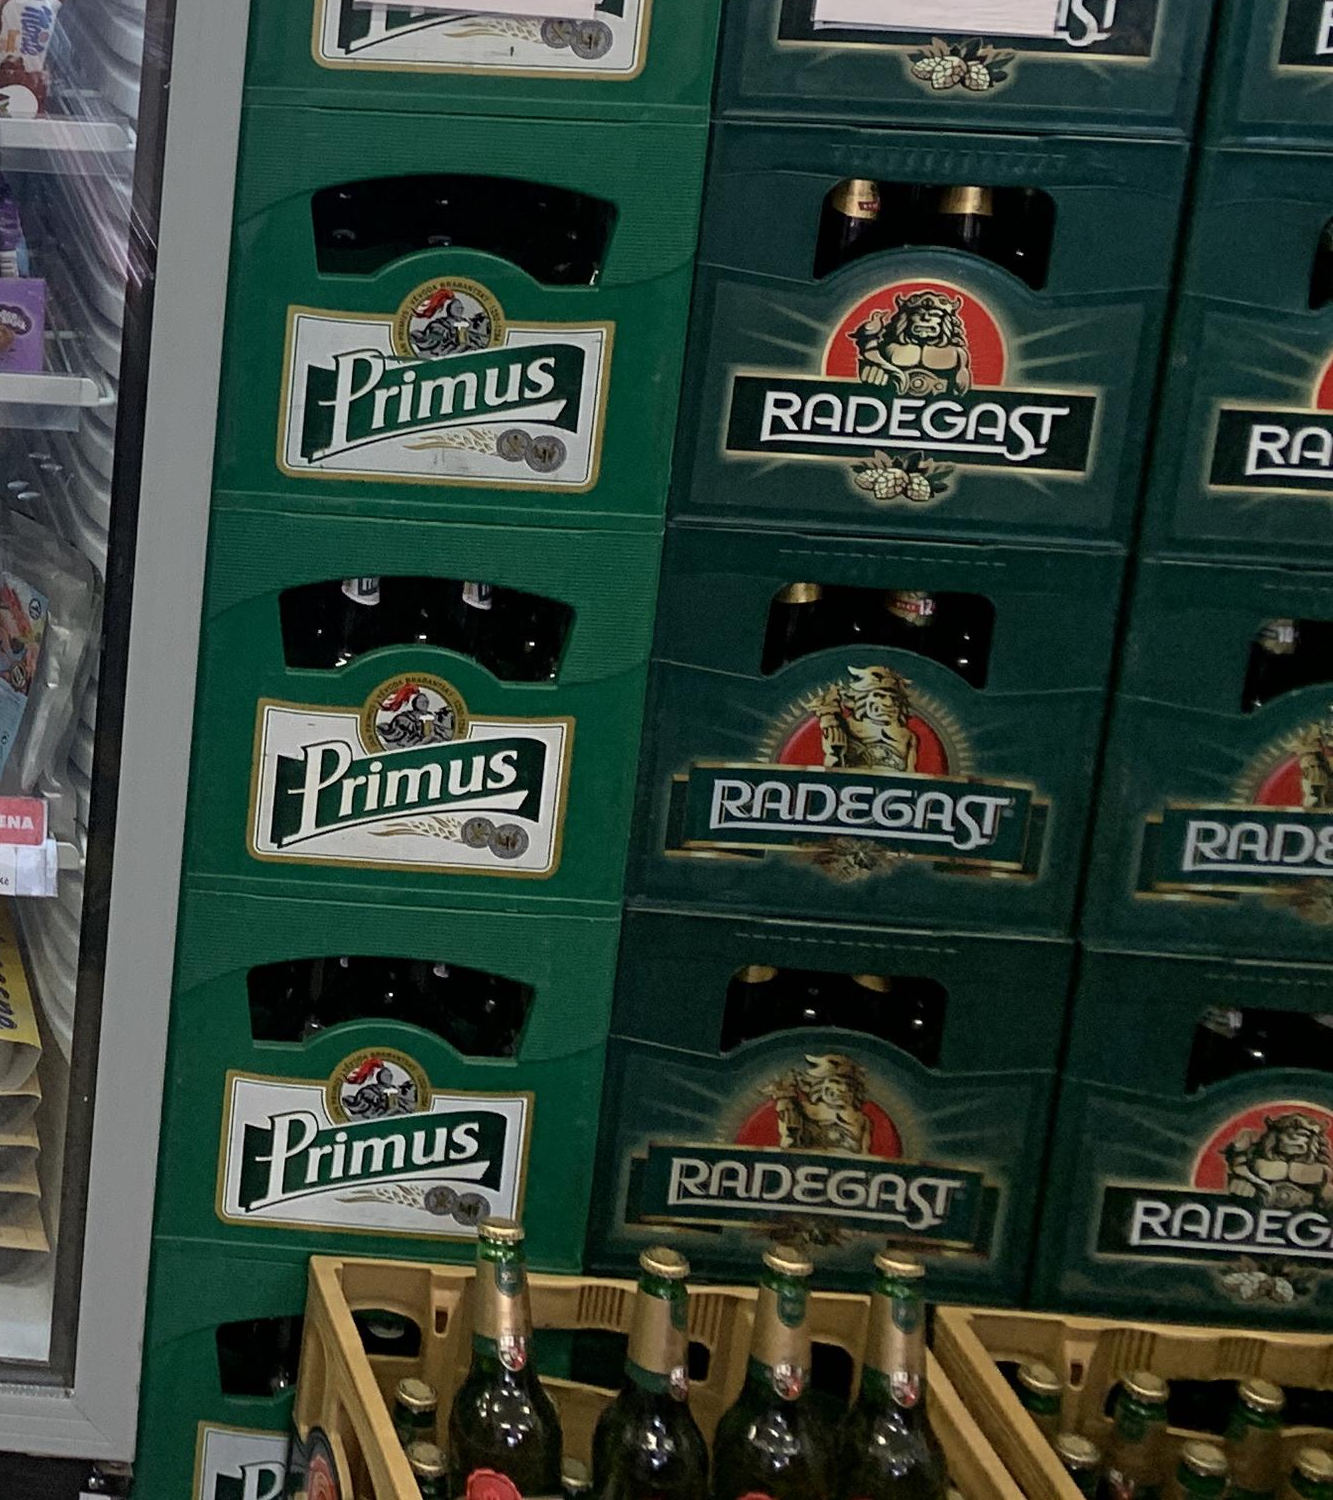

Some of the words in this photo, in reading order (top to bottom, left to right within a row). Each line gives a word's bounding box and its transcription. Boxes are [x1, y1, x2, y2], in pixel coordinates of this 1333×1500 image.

[317, 347, 557, 458] Primus
[760, 389, 1071, 461] RADEGAST
[286, 740, 518, 846] Primus
[709, 778, 1017, 850] RADEGAST
[254, 1110, 480, 1209] Primus
[667, 1156, 967, 1230] RADEGAST
